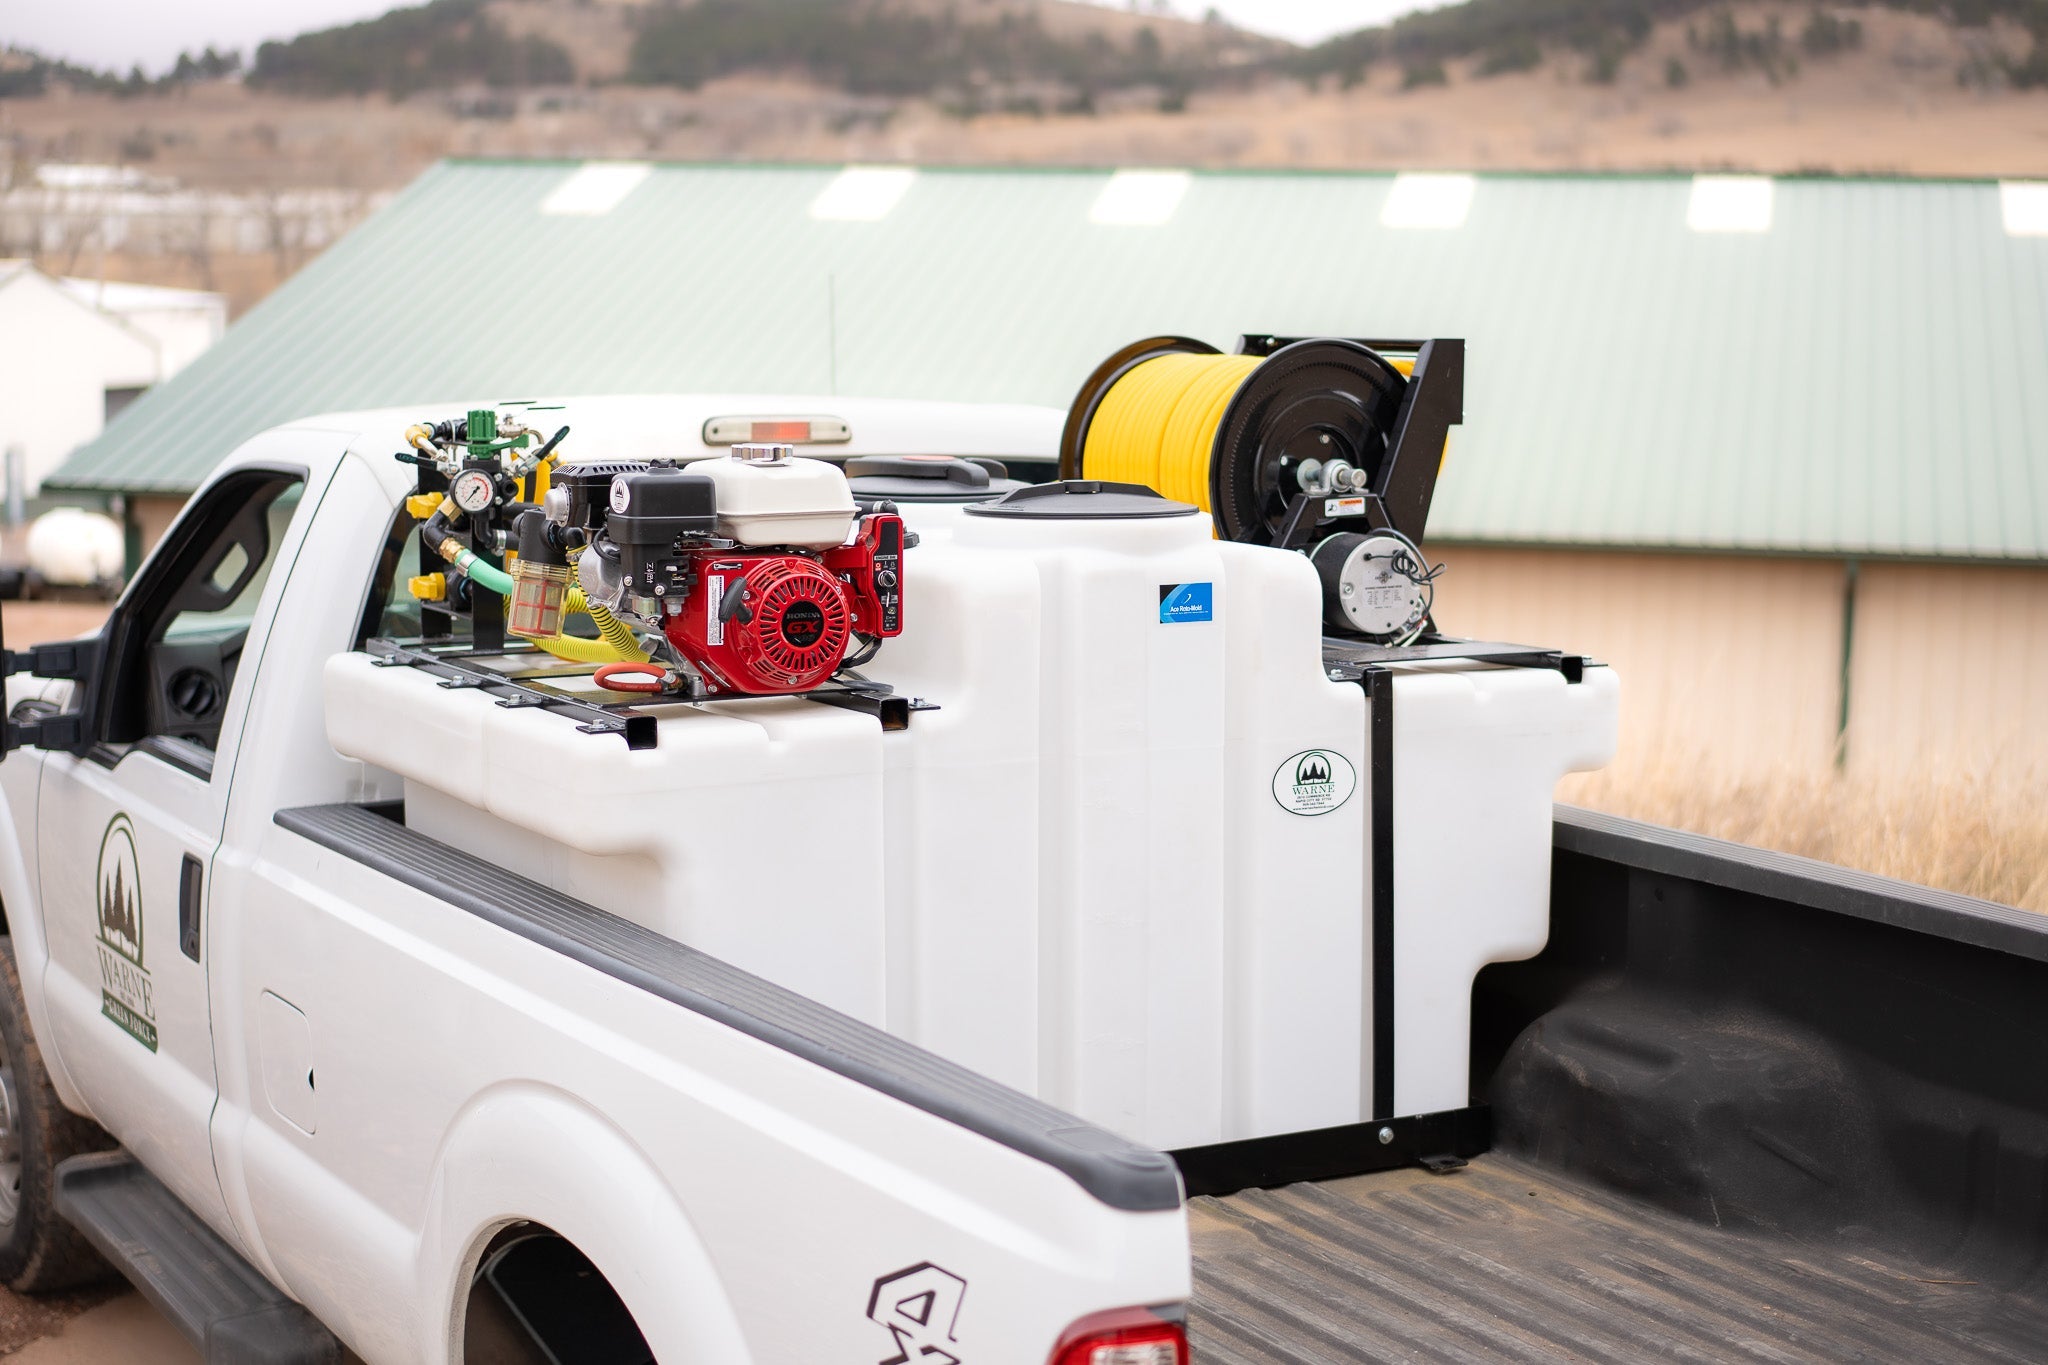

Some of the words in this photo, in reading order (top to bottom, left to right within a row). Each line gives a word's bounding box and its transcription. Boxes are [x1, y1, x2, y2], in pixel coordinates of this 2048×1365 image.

[787, 620, 819, 634] GX
[1292, 785, 1335, 795] WARNE
[97, 945, 155, 1021] WARNE
